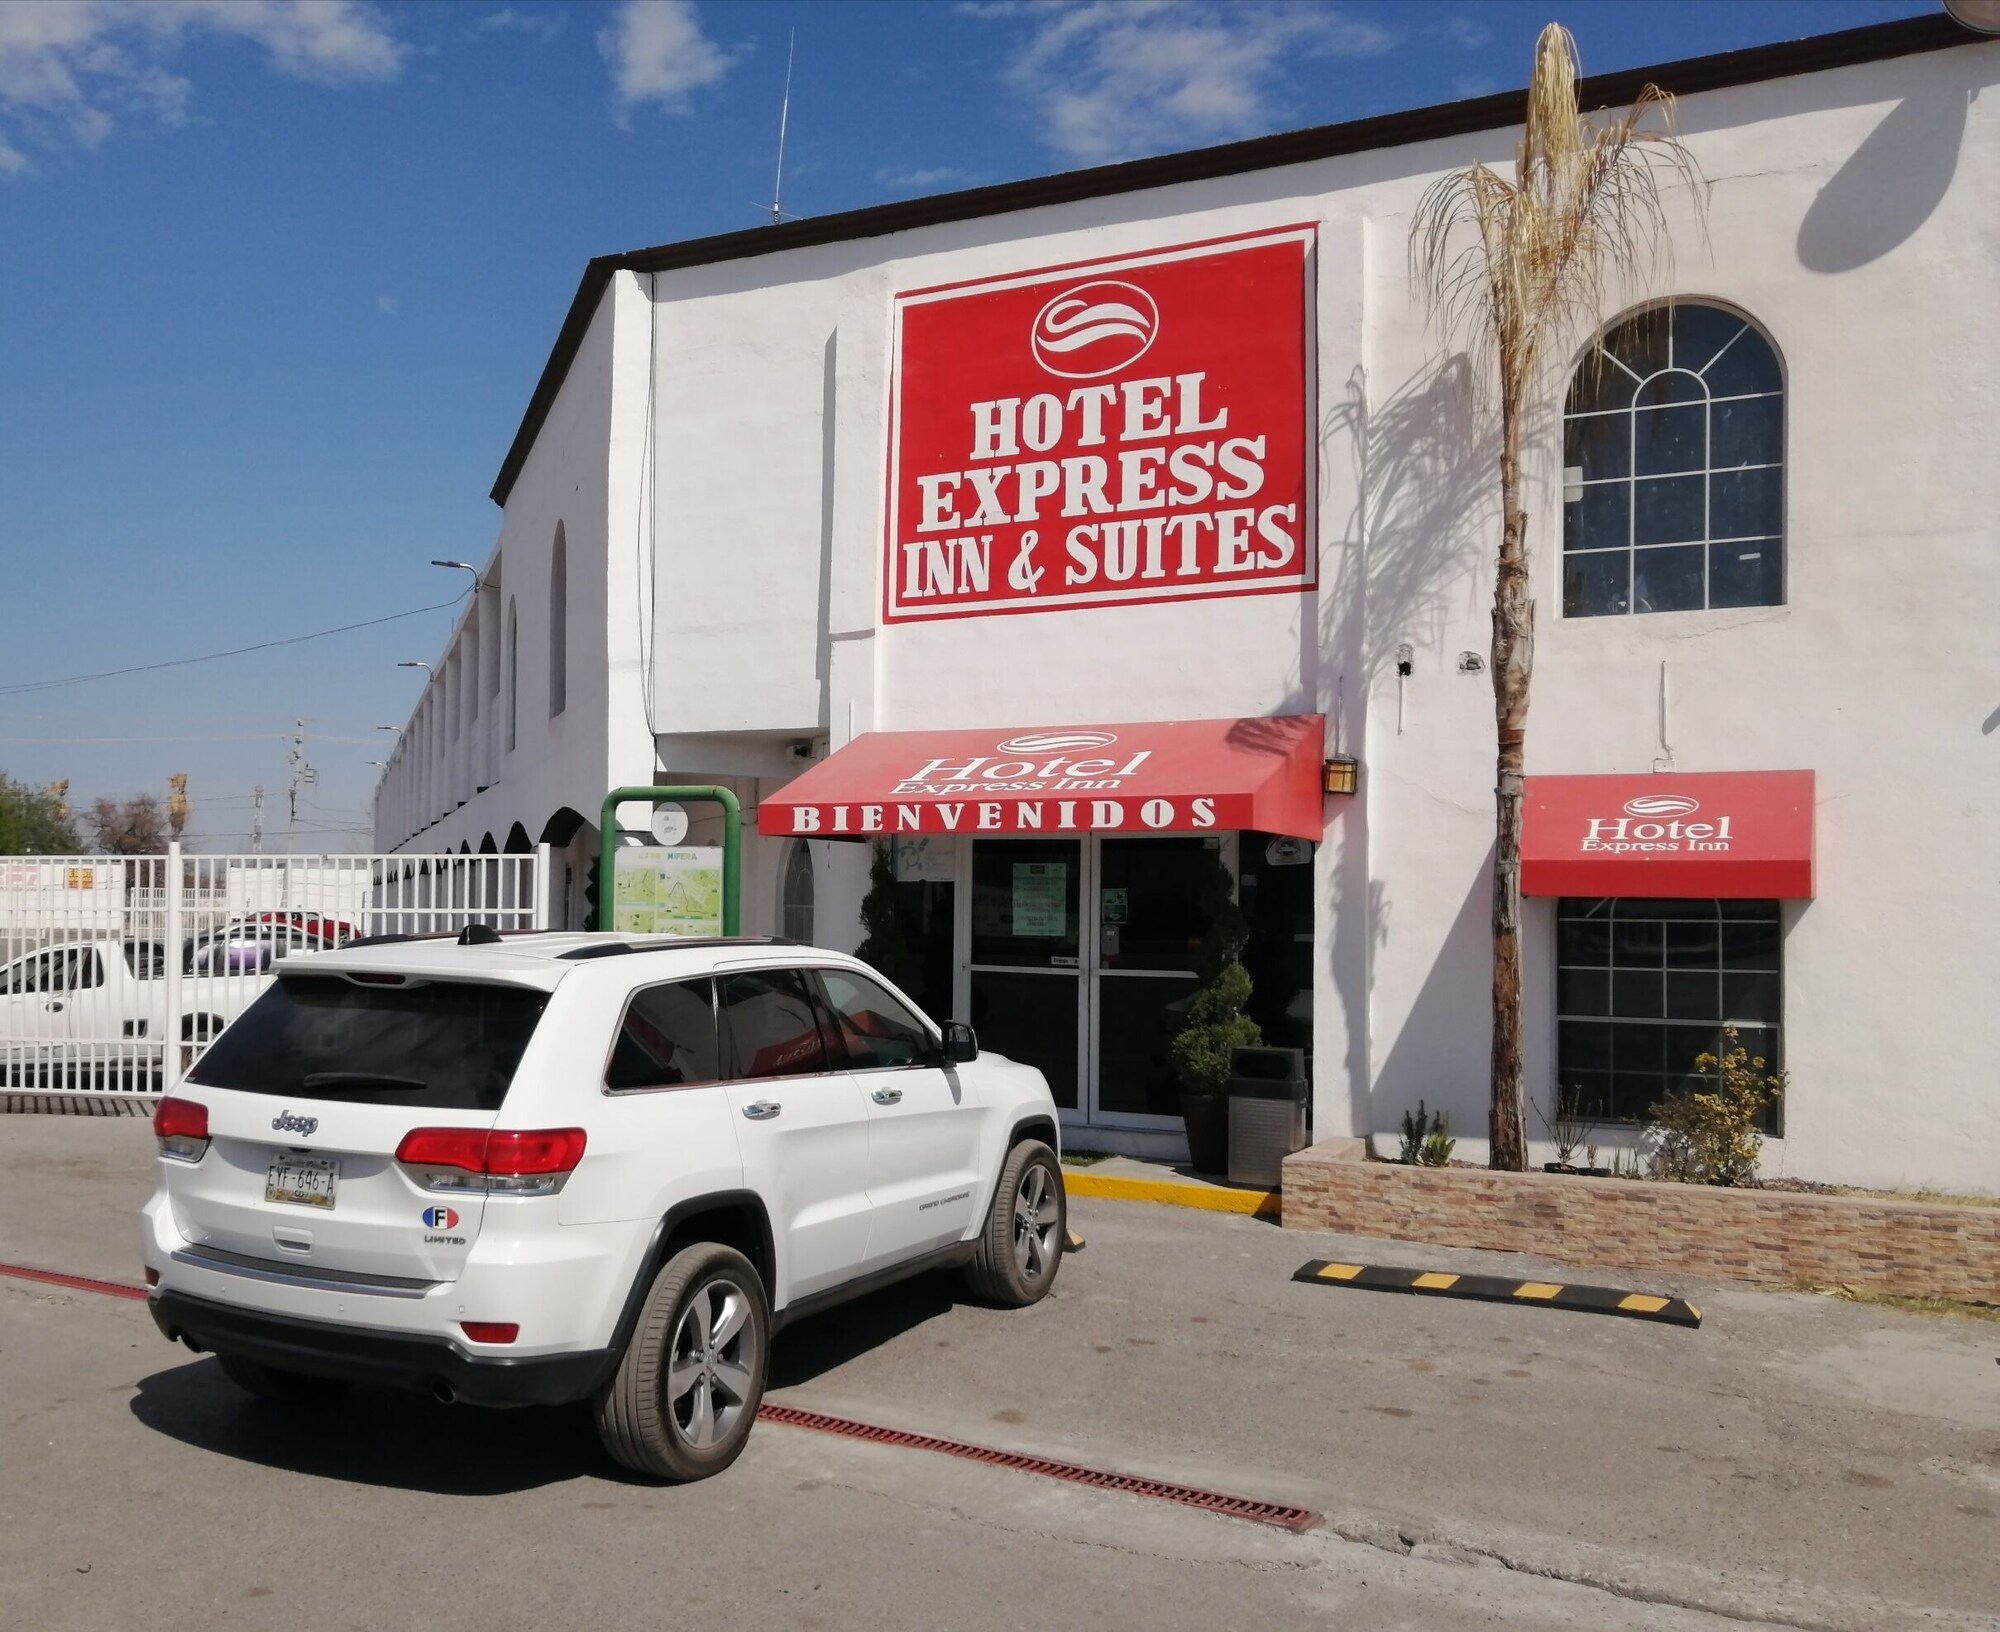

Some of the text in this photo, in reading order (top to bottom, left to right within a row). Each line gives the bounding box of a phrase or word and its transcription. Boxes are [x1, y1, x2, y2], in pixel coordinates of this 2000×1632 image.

[970, 372, 1228, 460] HOTEL
[917, 435, 1265, 532] EXPRESS
[902, 503, 1296, 598] INN & SUITES
[899, 751, 1152, 781] Hotel
[888, 777, 1122, 795] Express Inn
[791, 798, 1217, 832] BIENVENIDOS
[1583, 816, 1733, 840] Hotel
[1580, 839, 1729, 854] Express Inn
[271, 1109, 319, 1137] Jeep
[434, 1209, 446, 1227] F
[424, 1235, 466, 1245] LIMITED
